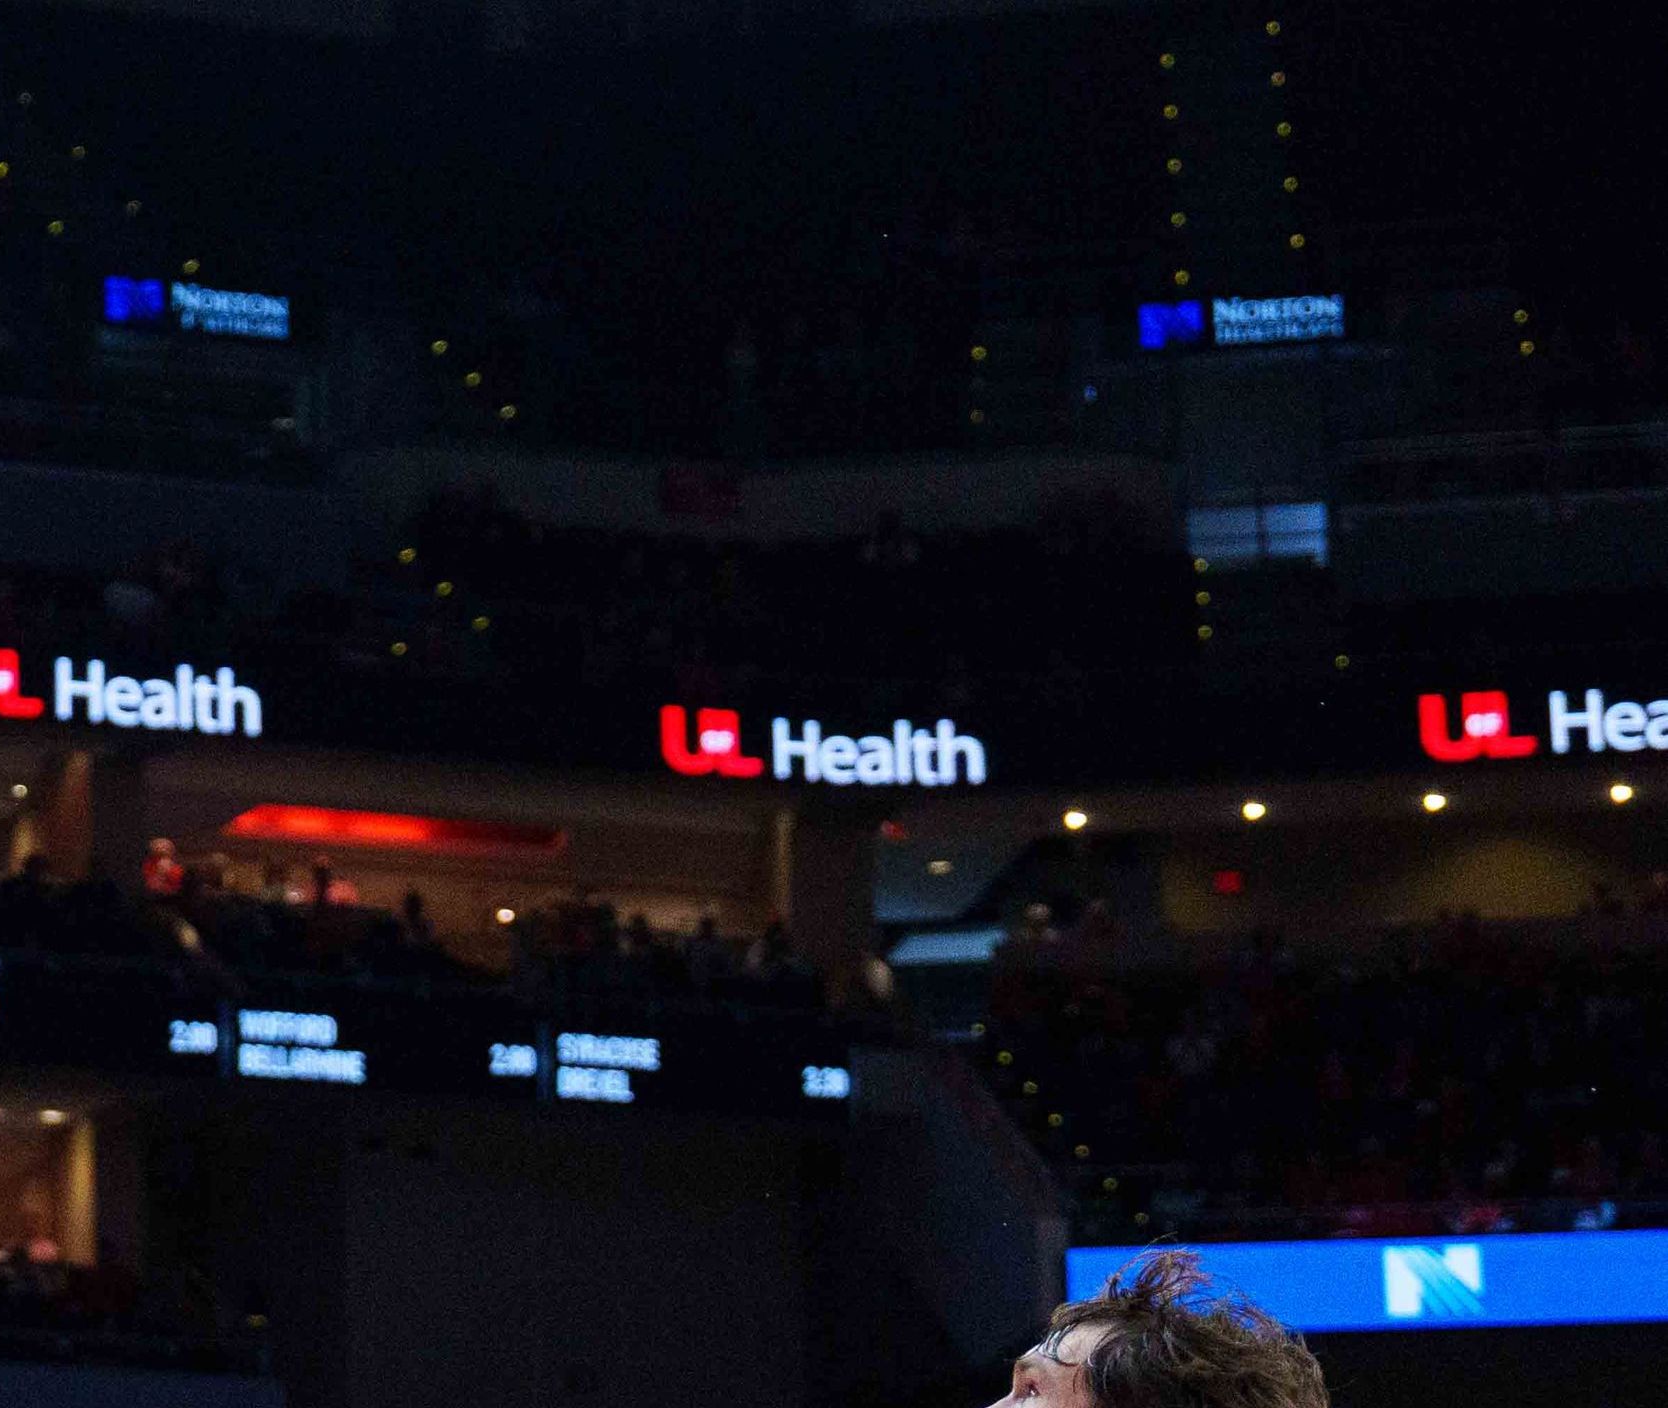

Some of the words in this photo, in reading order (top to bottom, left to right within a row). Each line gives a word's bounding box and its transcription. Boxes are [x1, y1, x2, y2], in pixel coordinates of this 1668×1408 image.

[54, 655, 262, 738] Health
[1548, 688, 1668, 755] Hea
[771, 716, 987, 786] Health
